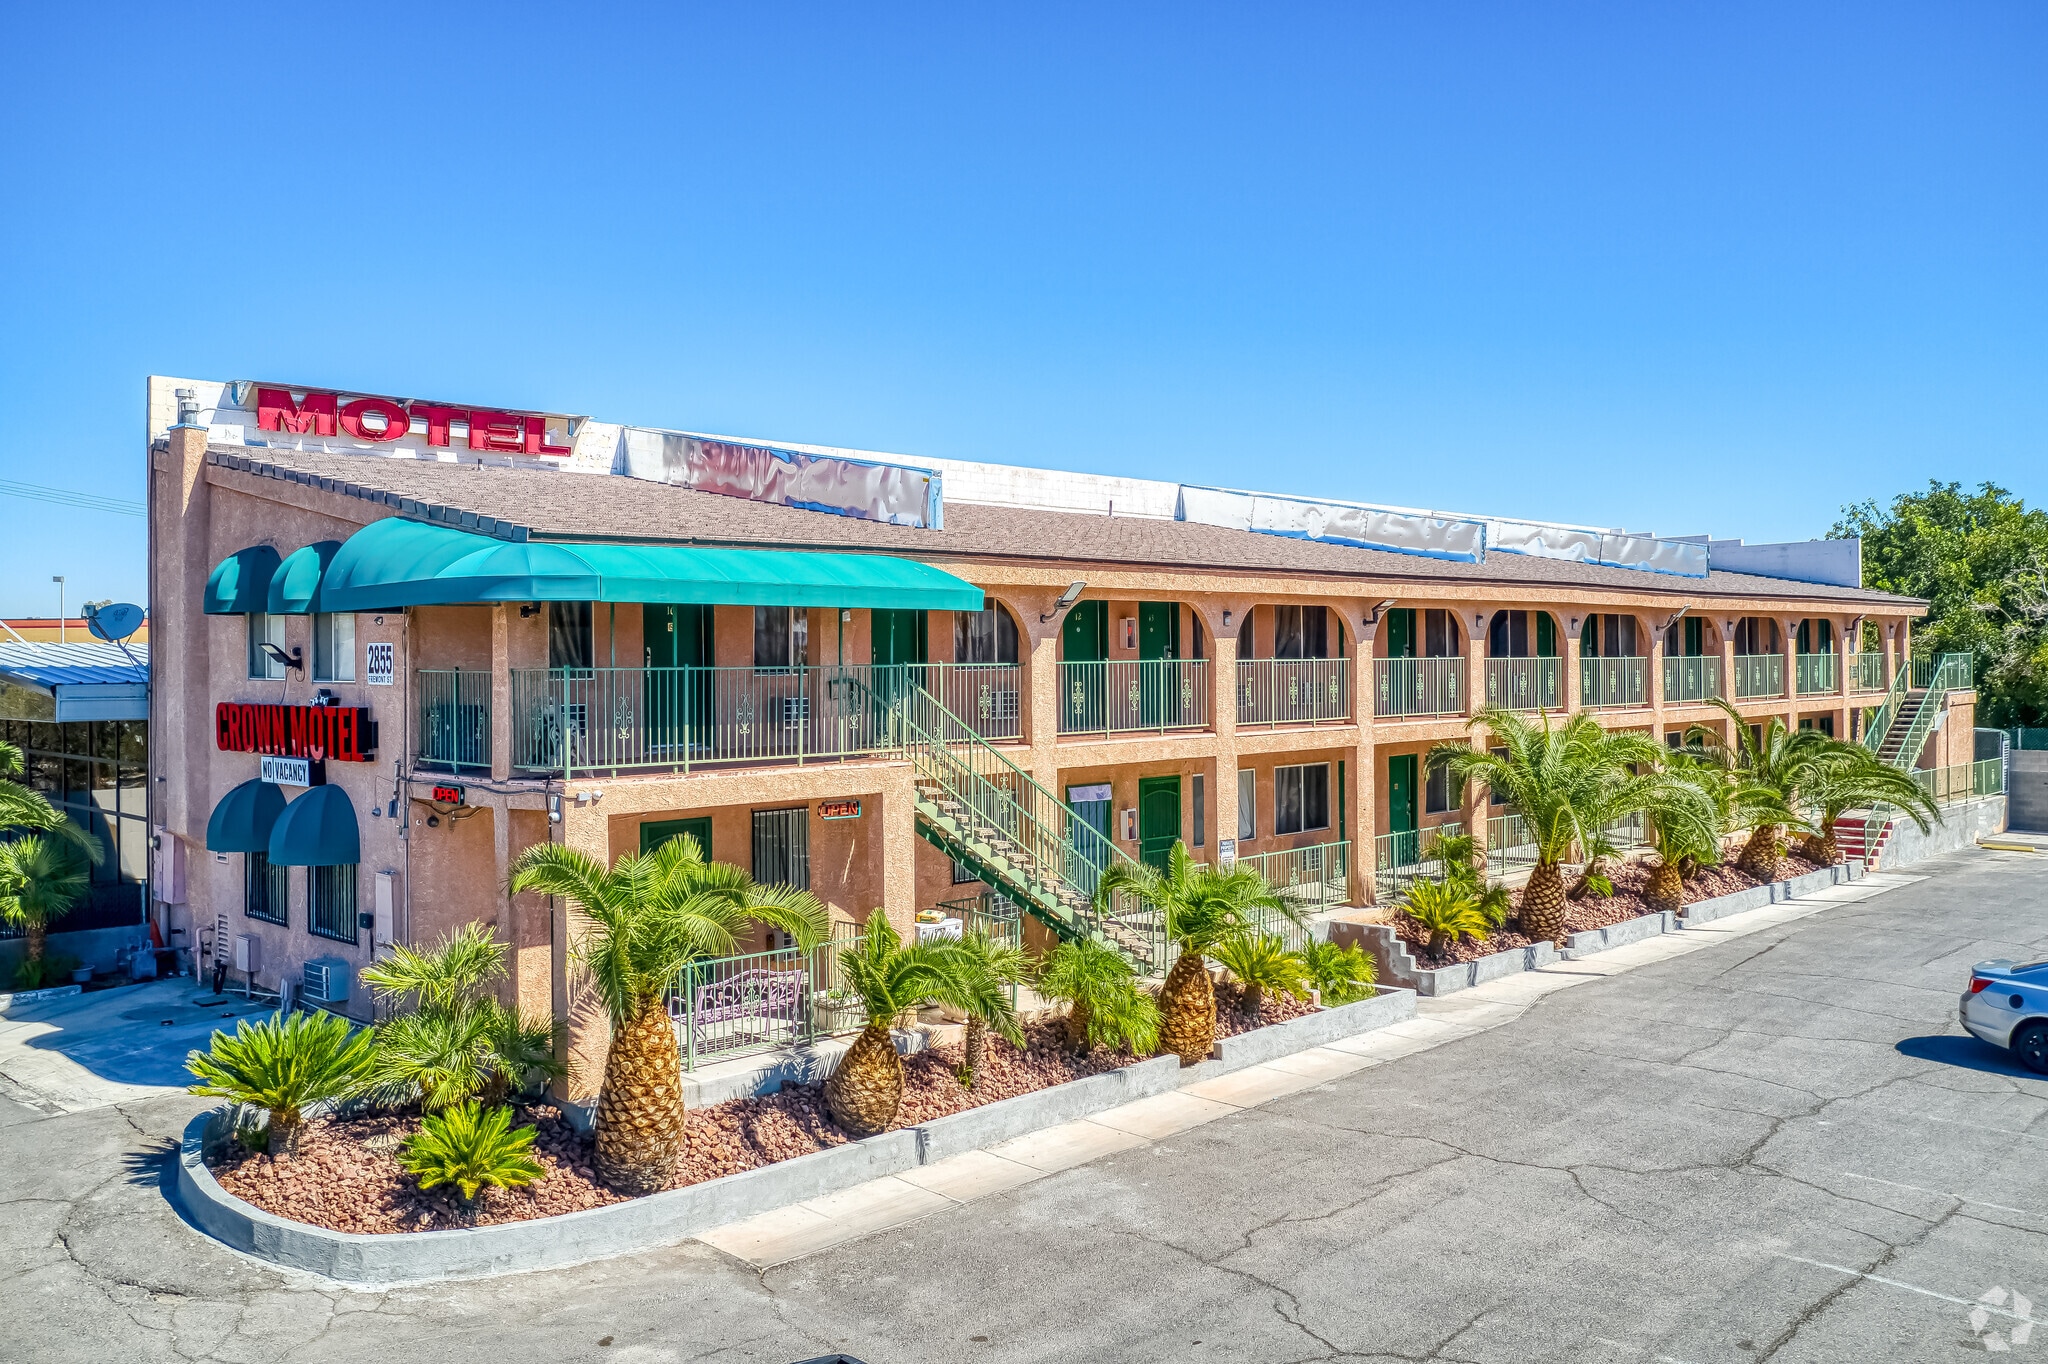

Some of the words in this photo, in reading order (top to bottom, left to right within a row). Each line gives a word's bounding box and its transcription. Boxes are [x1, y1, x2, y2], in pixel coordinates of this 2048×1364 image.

[257, 388, 571, 456] MOTEL
[368, 645, 392, 674] 2855
[368, 675, 386, 683] FREMONT
[216, 702, 286, 756] CROWN
[290, 705, 364, 763] MOTEL
[262, 760, 272, 778] NO
[275, 761, 307, 783] VACANCY
[432, 787, 459, 803] OPEN
[820, 802, 858, 817] OPEN
